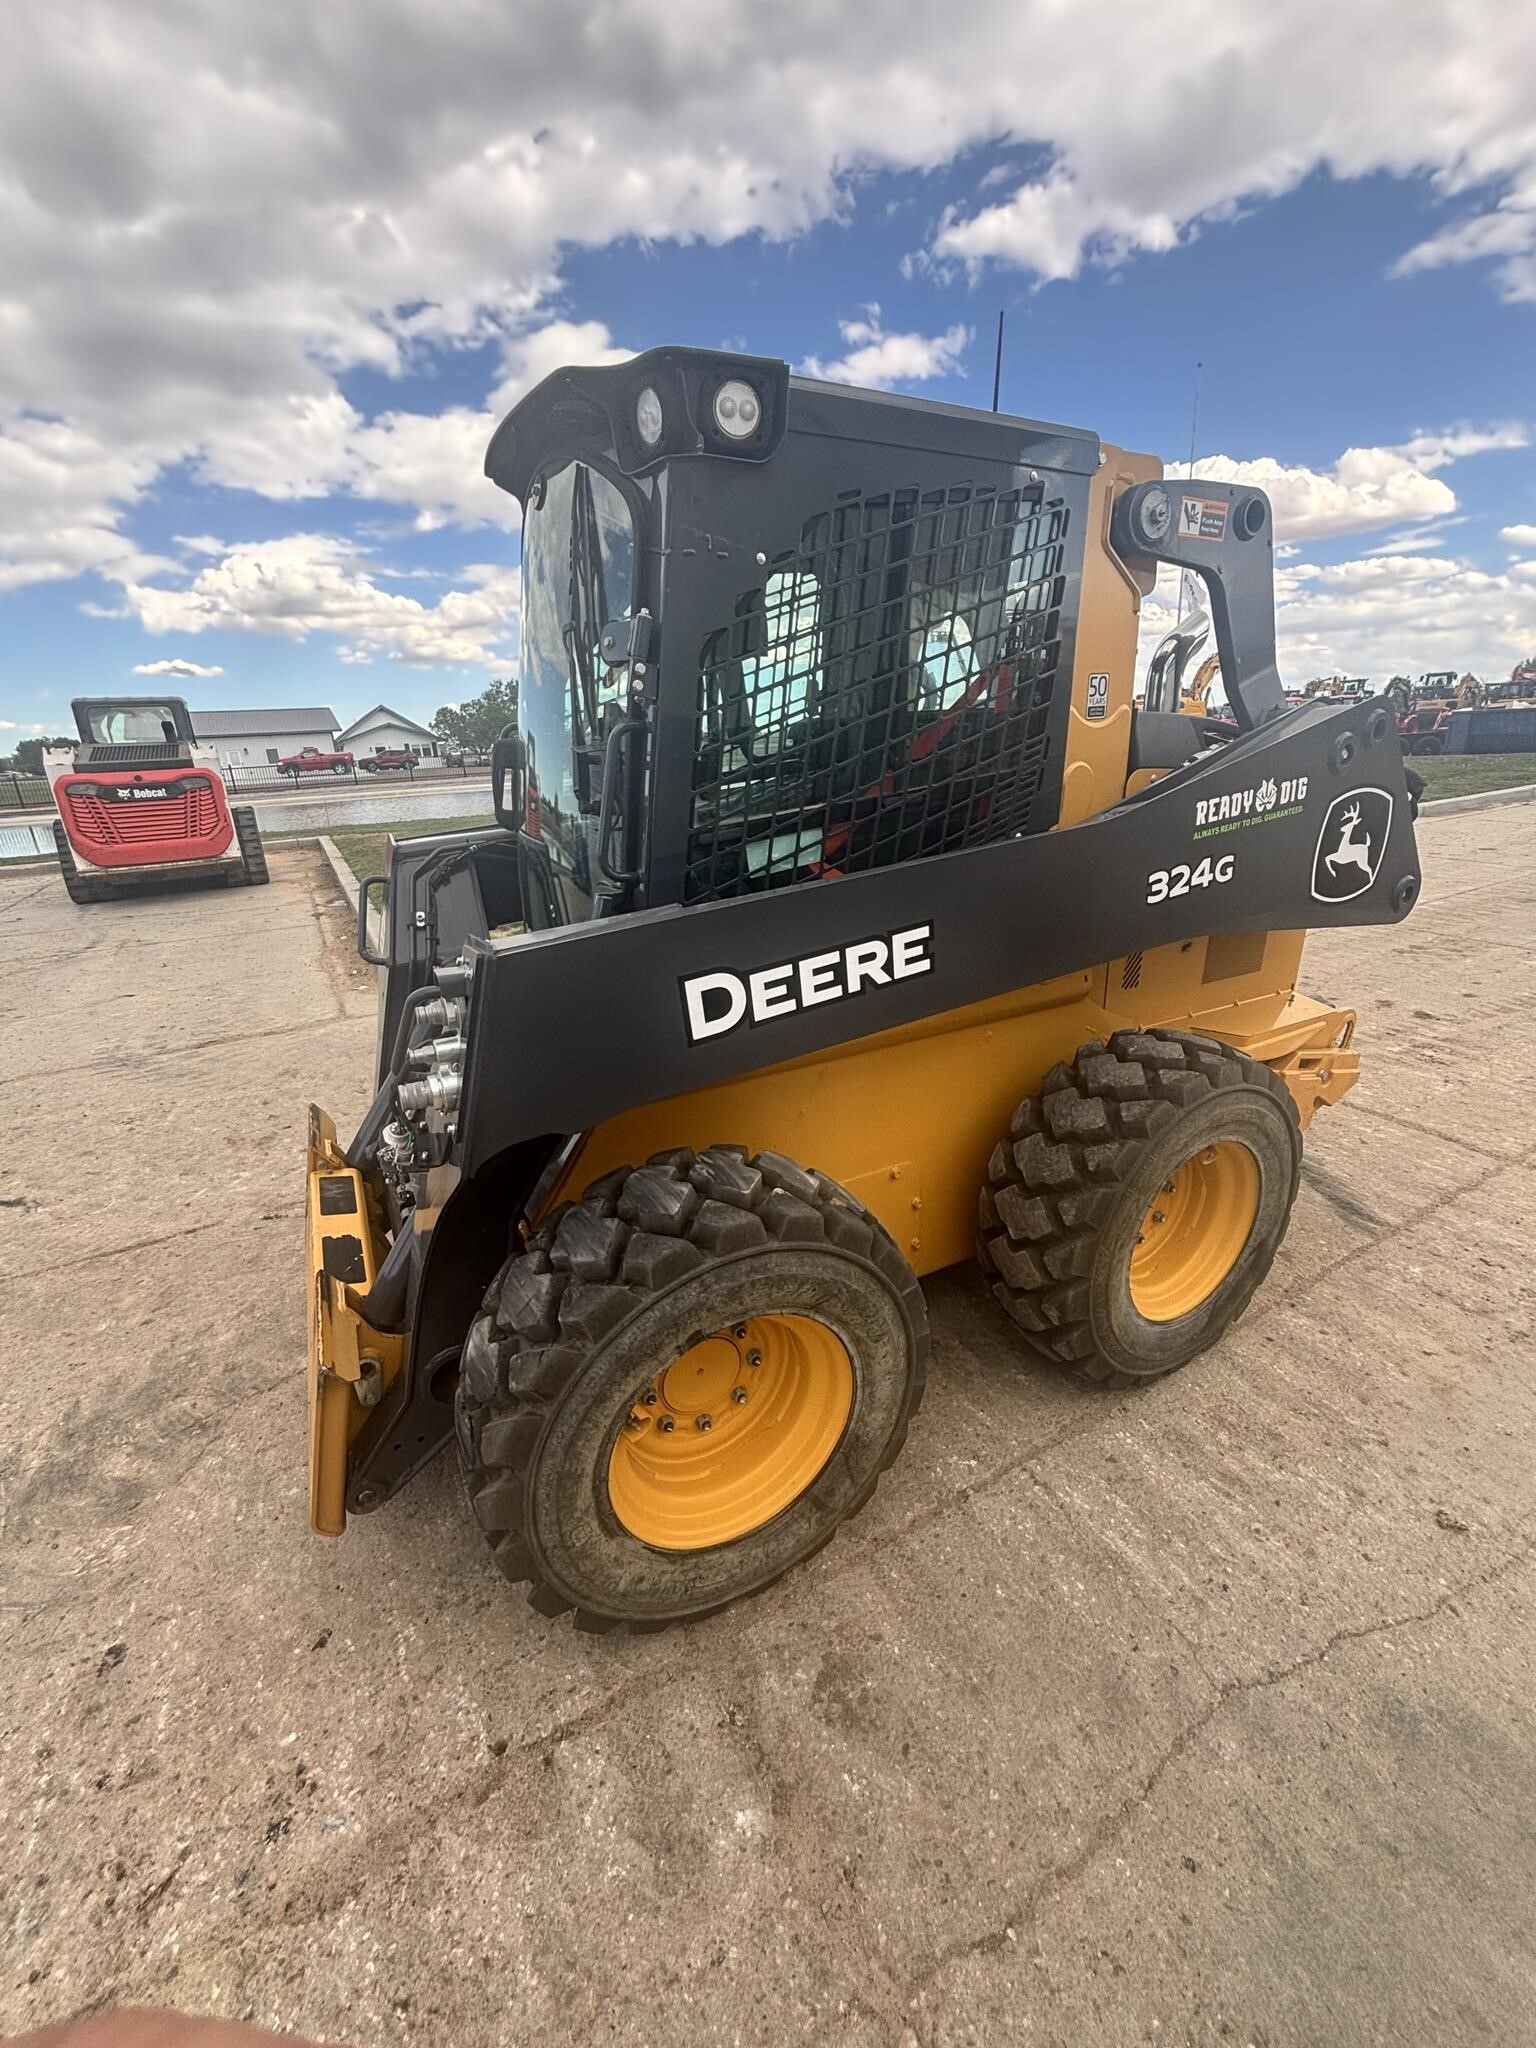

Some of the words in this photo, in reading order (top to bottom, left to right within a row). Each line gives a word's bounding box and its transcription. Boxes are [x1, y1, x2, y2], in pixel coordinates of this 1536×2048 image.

[1089, 675, 1107, 697] 50
[1089, 697, 1106, 705] YEARS
[133, 788, 167, 799] Bobcat
[1195, 789, 1254, 826] READY
[1280, 776, 1308, 805] DIG
[1193, 826, 1220, 841] ALWAYS
[1219, 822, 1241, 833] READY
[1242, 819, 1251, 827] TO
[1264, 805, 1304, 821] GUARANTEED.
[1146, 854, 1235, 904] 324G
[683, 924, 932, 1042] DEERE
